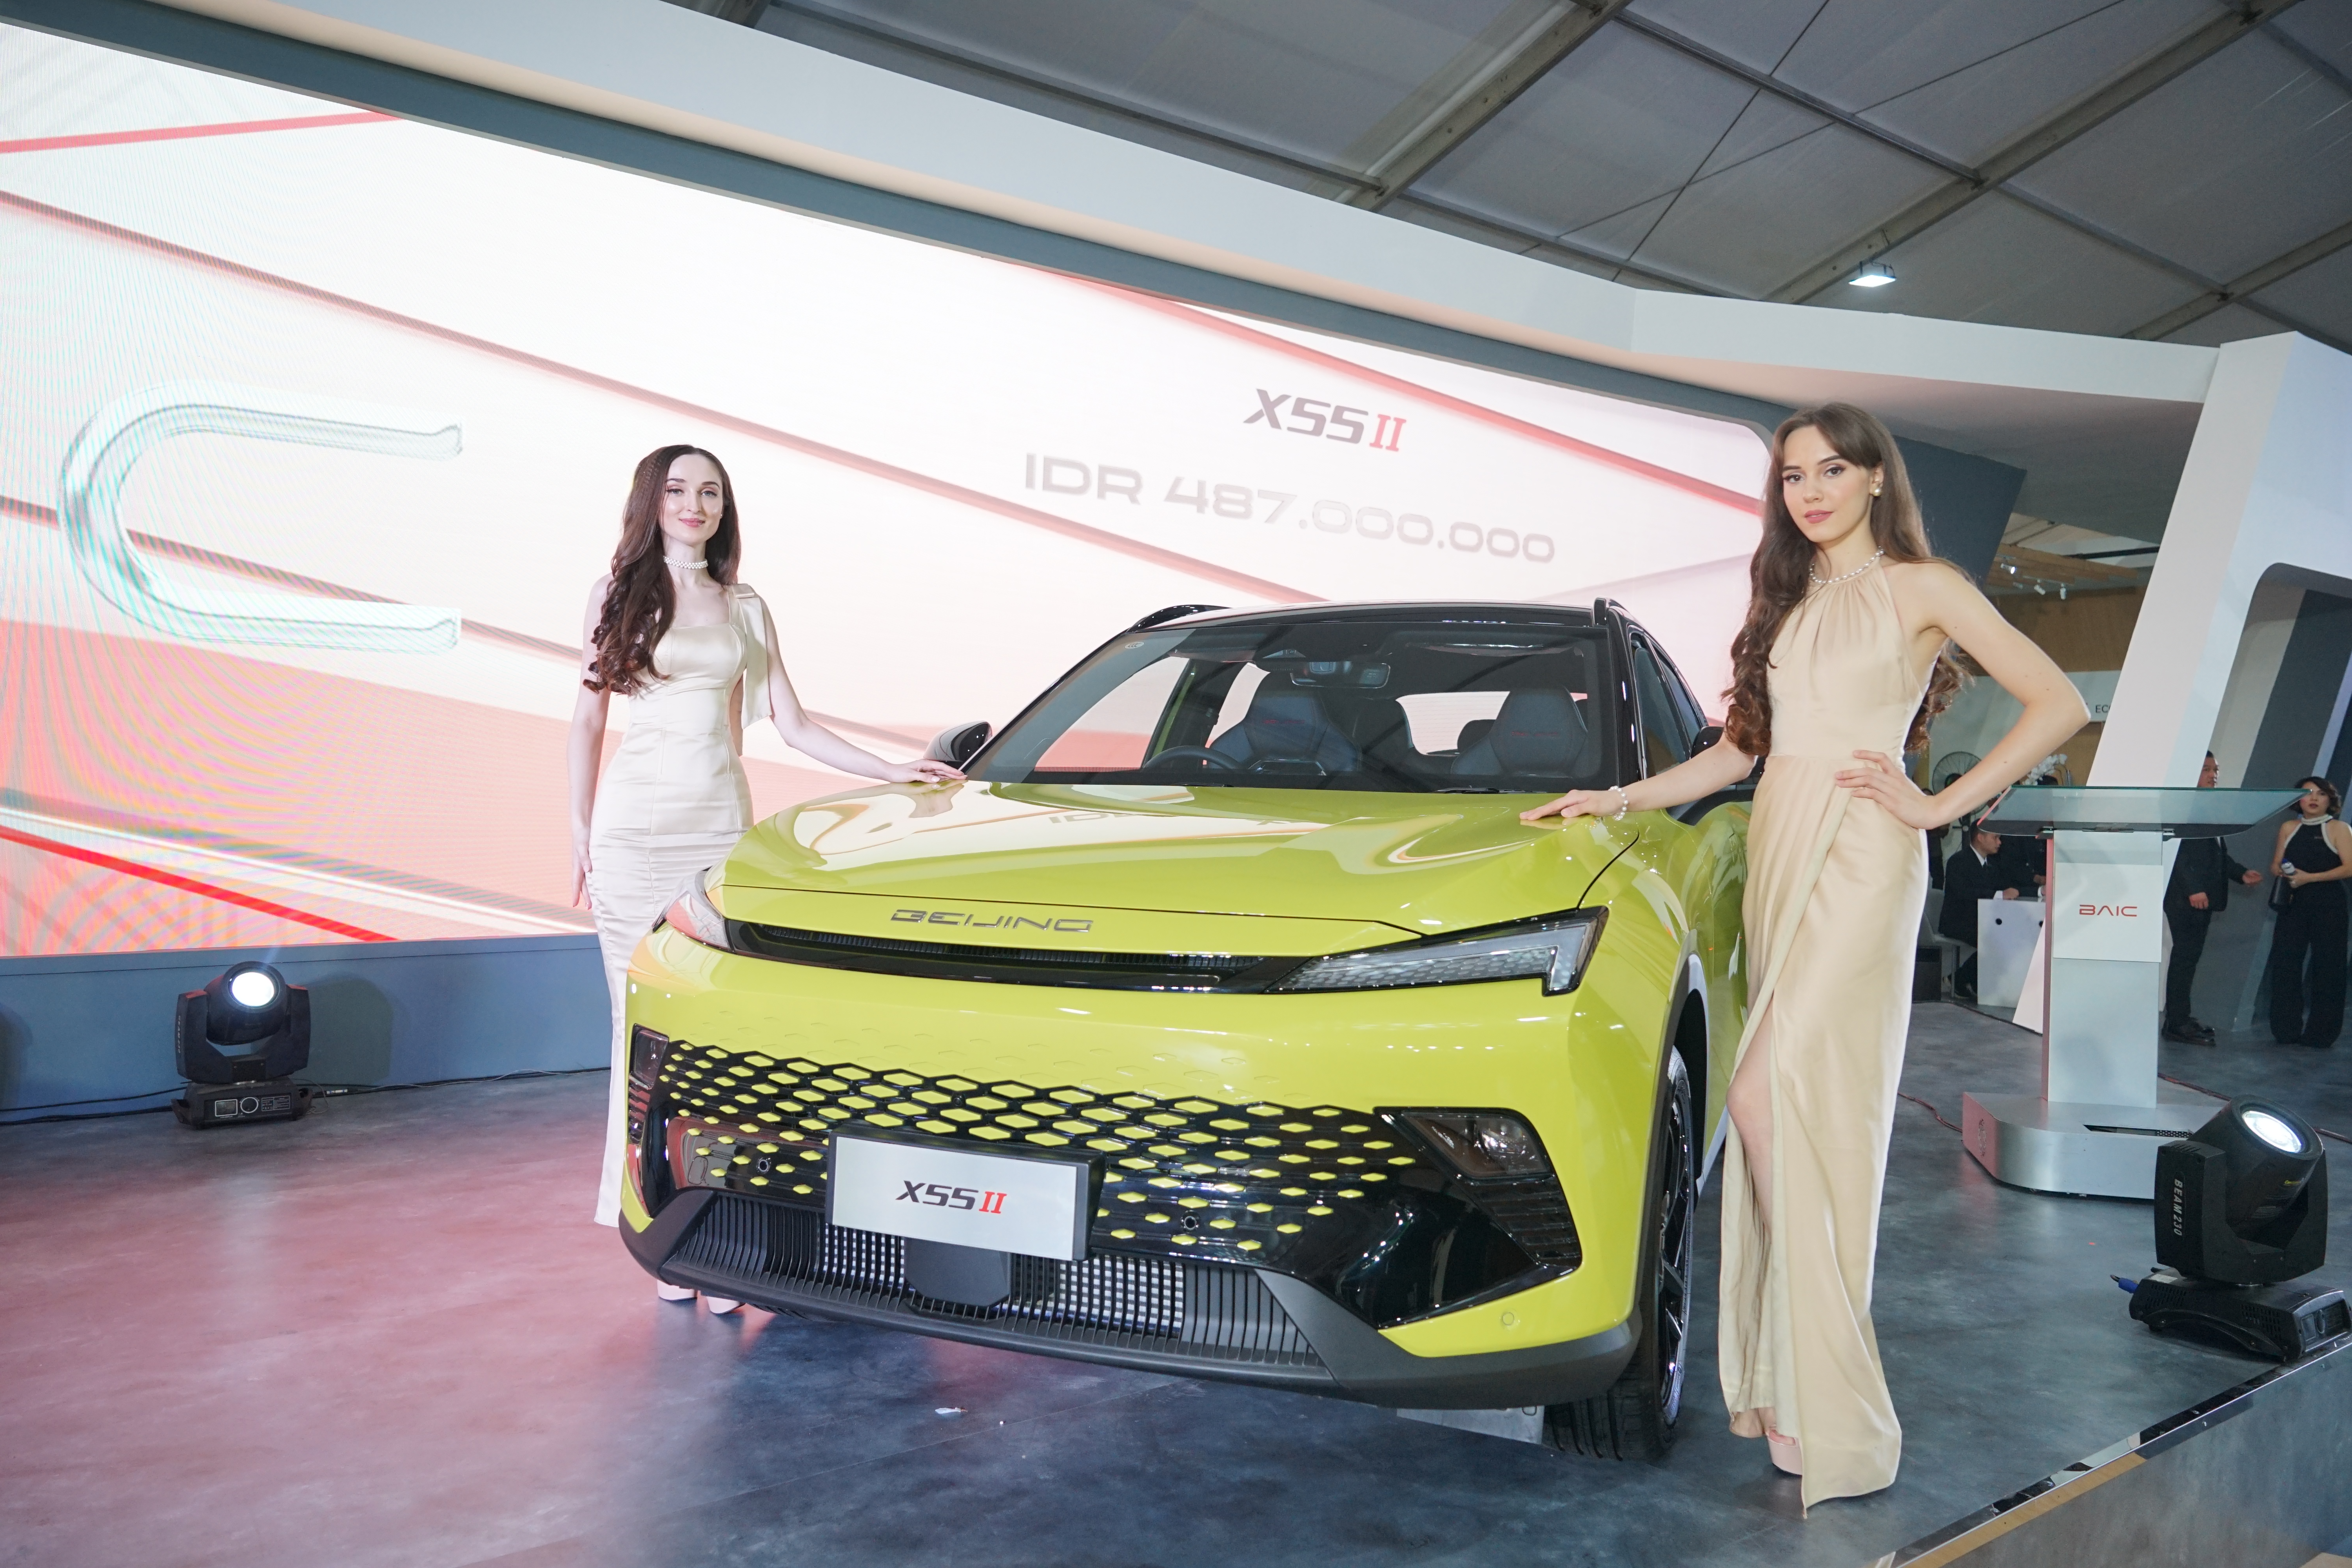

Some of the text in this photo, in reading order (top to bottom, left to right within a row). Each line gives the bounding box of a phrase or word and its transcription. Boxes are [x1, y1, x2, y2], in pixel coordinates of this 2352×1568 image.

[1024, 452, 1142, 505] IDR
[2095, 704, 2111, 713] EC
[2079, 904, 2137, 917] BAIC
[891, 909, 1093, 933] BEIJING
